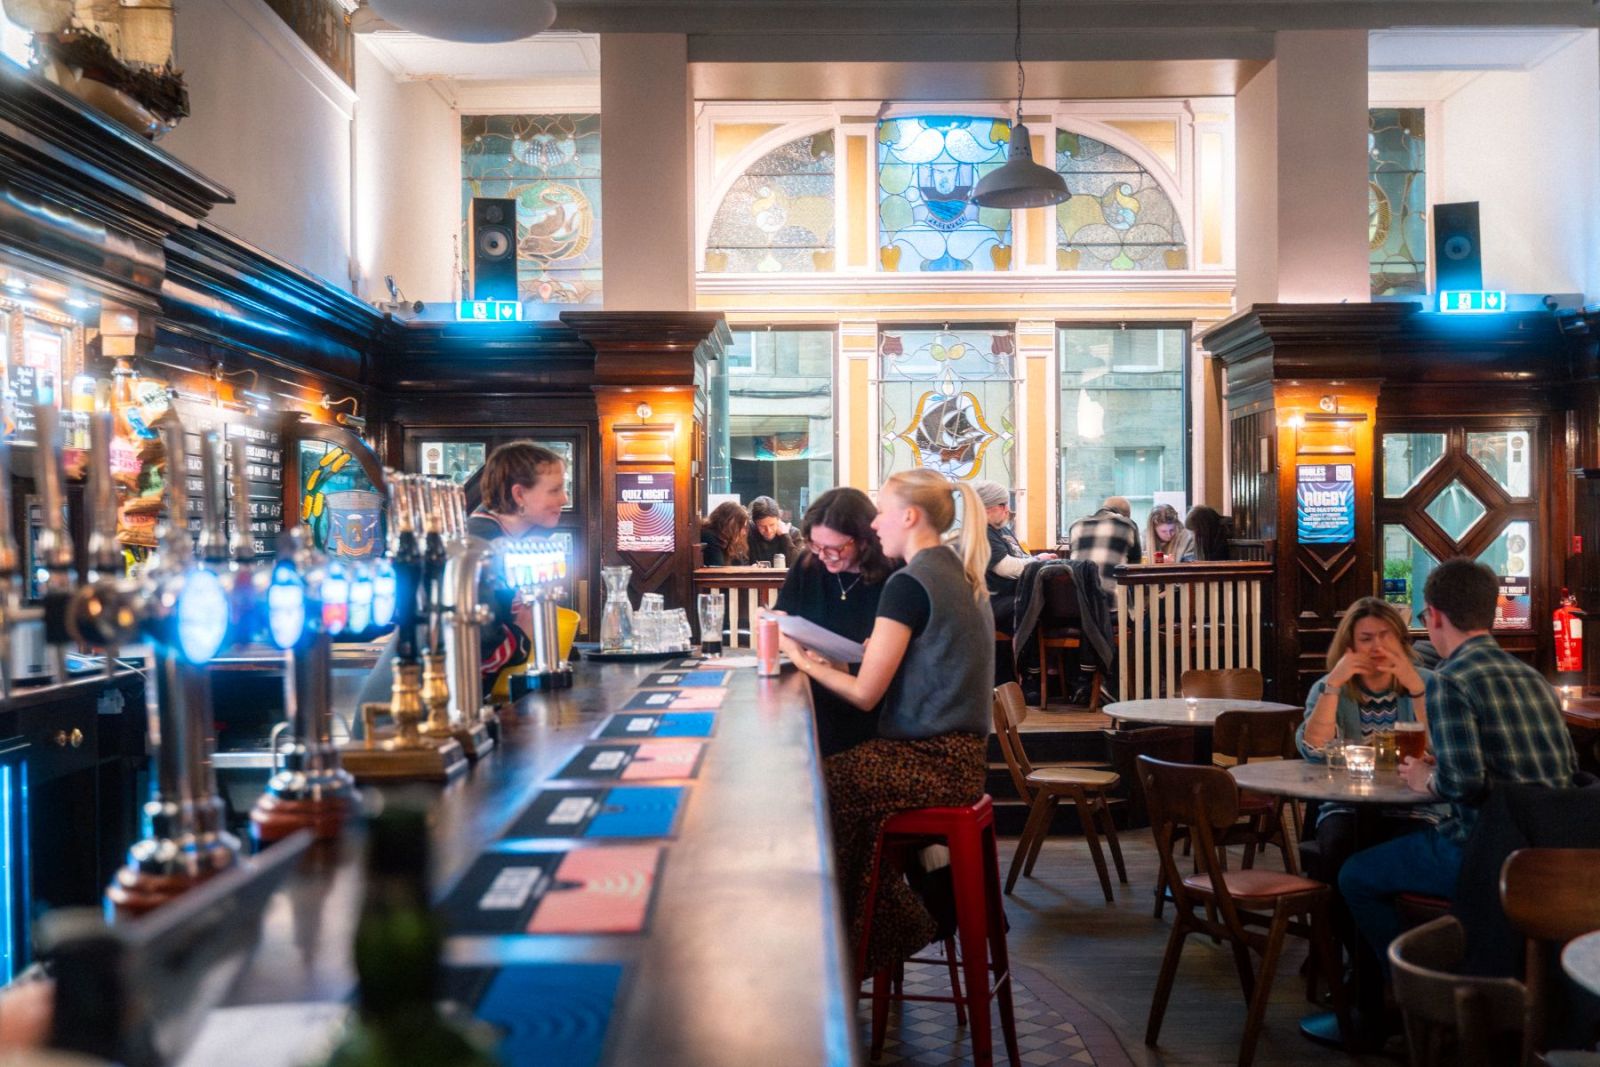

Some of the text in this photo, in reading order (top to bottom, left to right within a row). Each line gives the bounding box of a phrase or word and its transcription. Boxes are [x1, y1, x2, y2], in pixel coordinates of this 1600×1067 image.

[622, 489, 670, 501] QUIZ NIGHT
[1304, 491, 1347, 507] RUGBY
